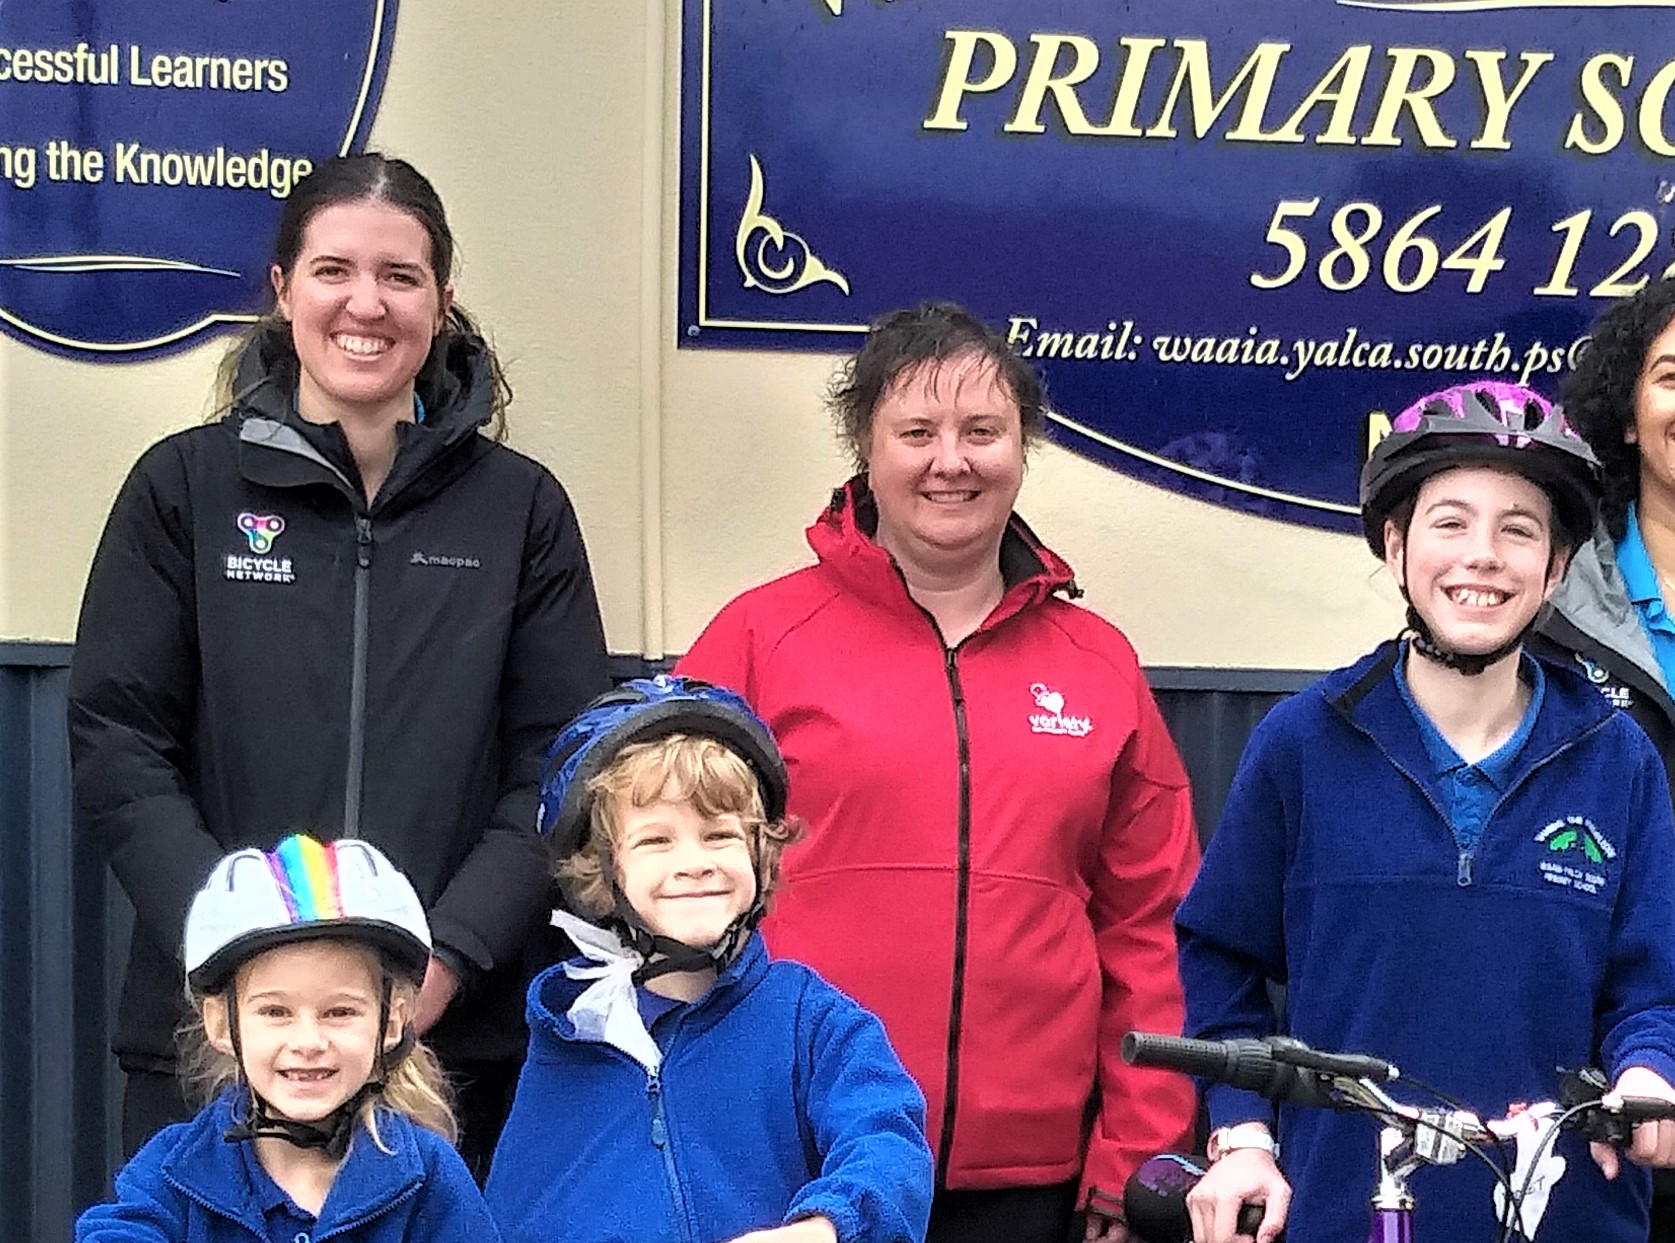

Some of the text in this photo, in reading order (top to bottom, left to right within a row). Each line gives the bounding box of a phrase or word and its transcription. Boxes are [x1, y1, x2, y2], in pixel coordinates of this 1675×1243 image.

[0, 43, 289, 92] cessful Learners
[923, 29, 1556, 151] PRIMARY
[46, 141, 104, 182] the
[115, 142, 313, 198] Knowledge
[1251, 198, 1514, 294] 5864
[1007, 317, 1143, 361] Email:
[226, 570, 292, 583] NETWORK
[227, 555, 292, 573] BICYCLE
